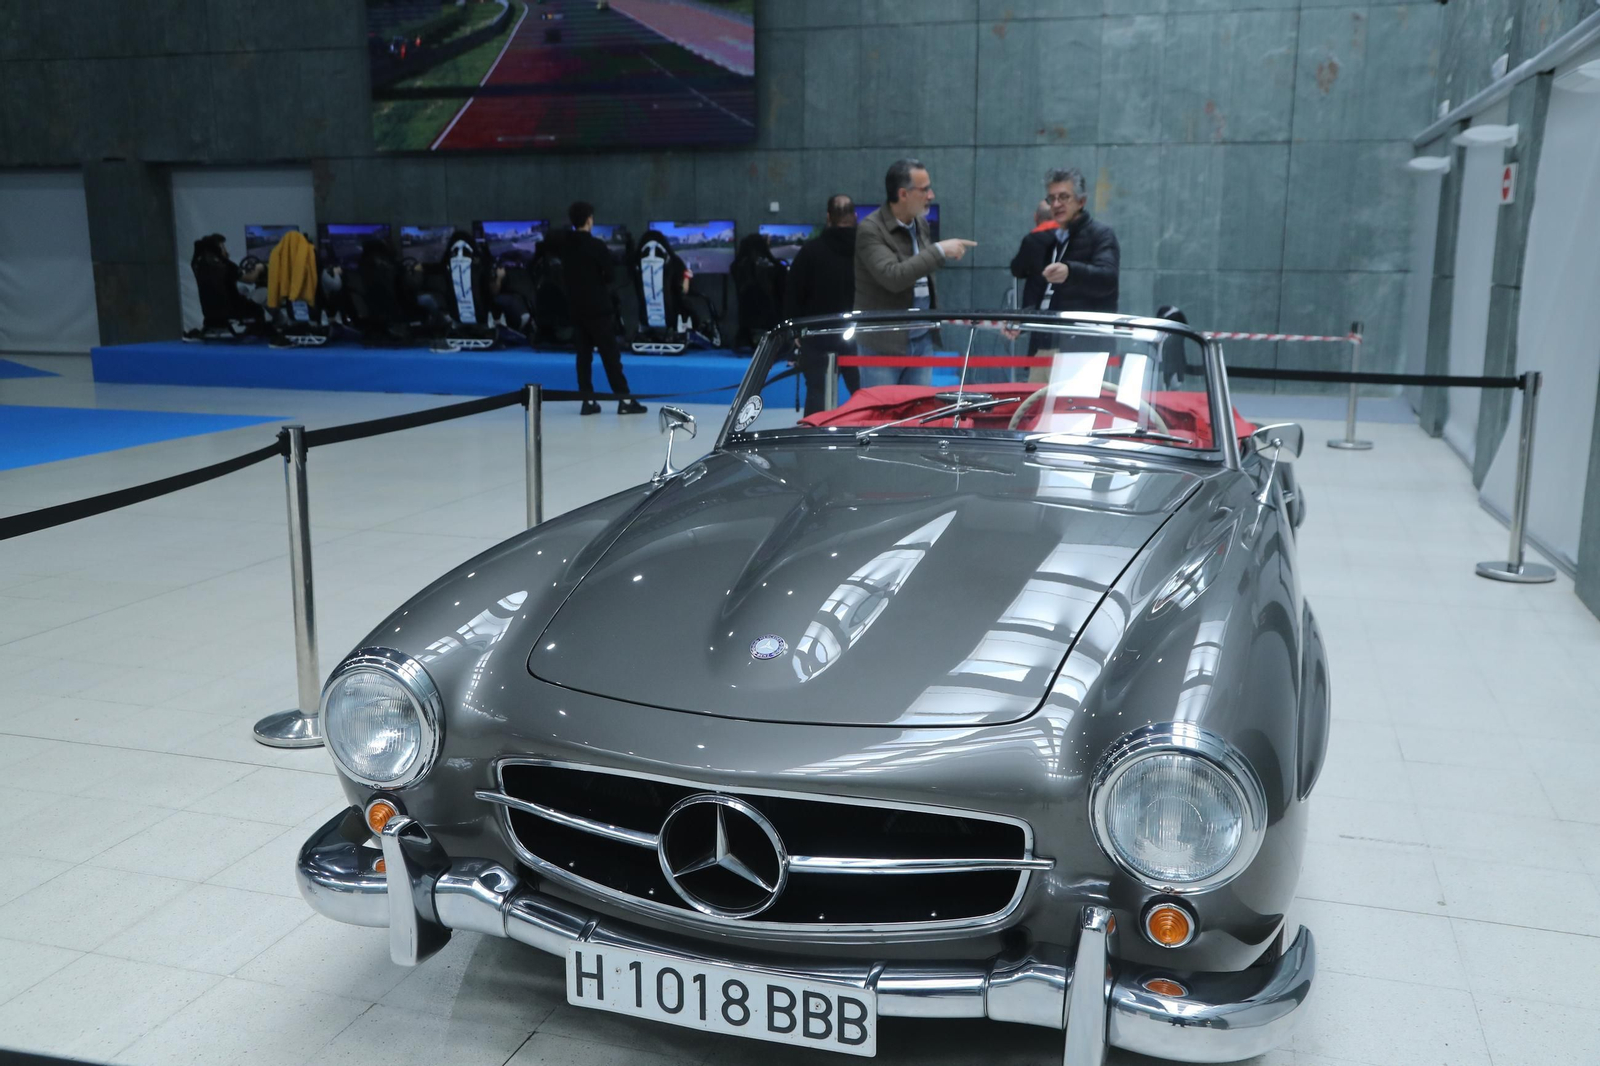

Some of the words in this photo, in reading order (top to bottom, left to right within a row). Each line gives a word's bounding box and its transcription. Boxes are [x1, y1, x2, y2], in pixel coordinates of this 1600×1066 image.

[575, 951, 604, 1001] H
[629, 961, 751, 1027] 1018
[766, 984, 868, 1046] BBB
